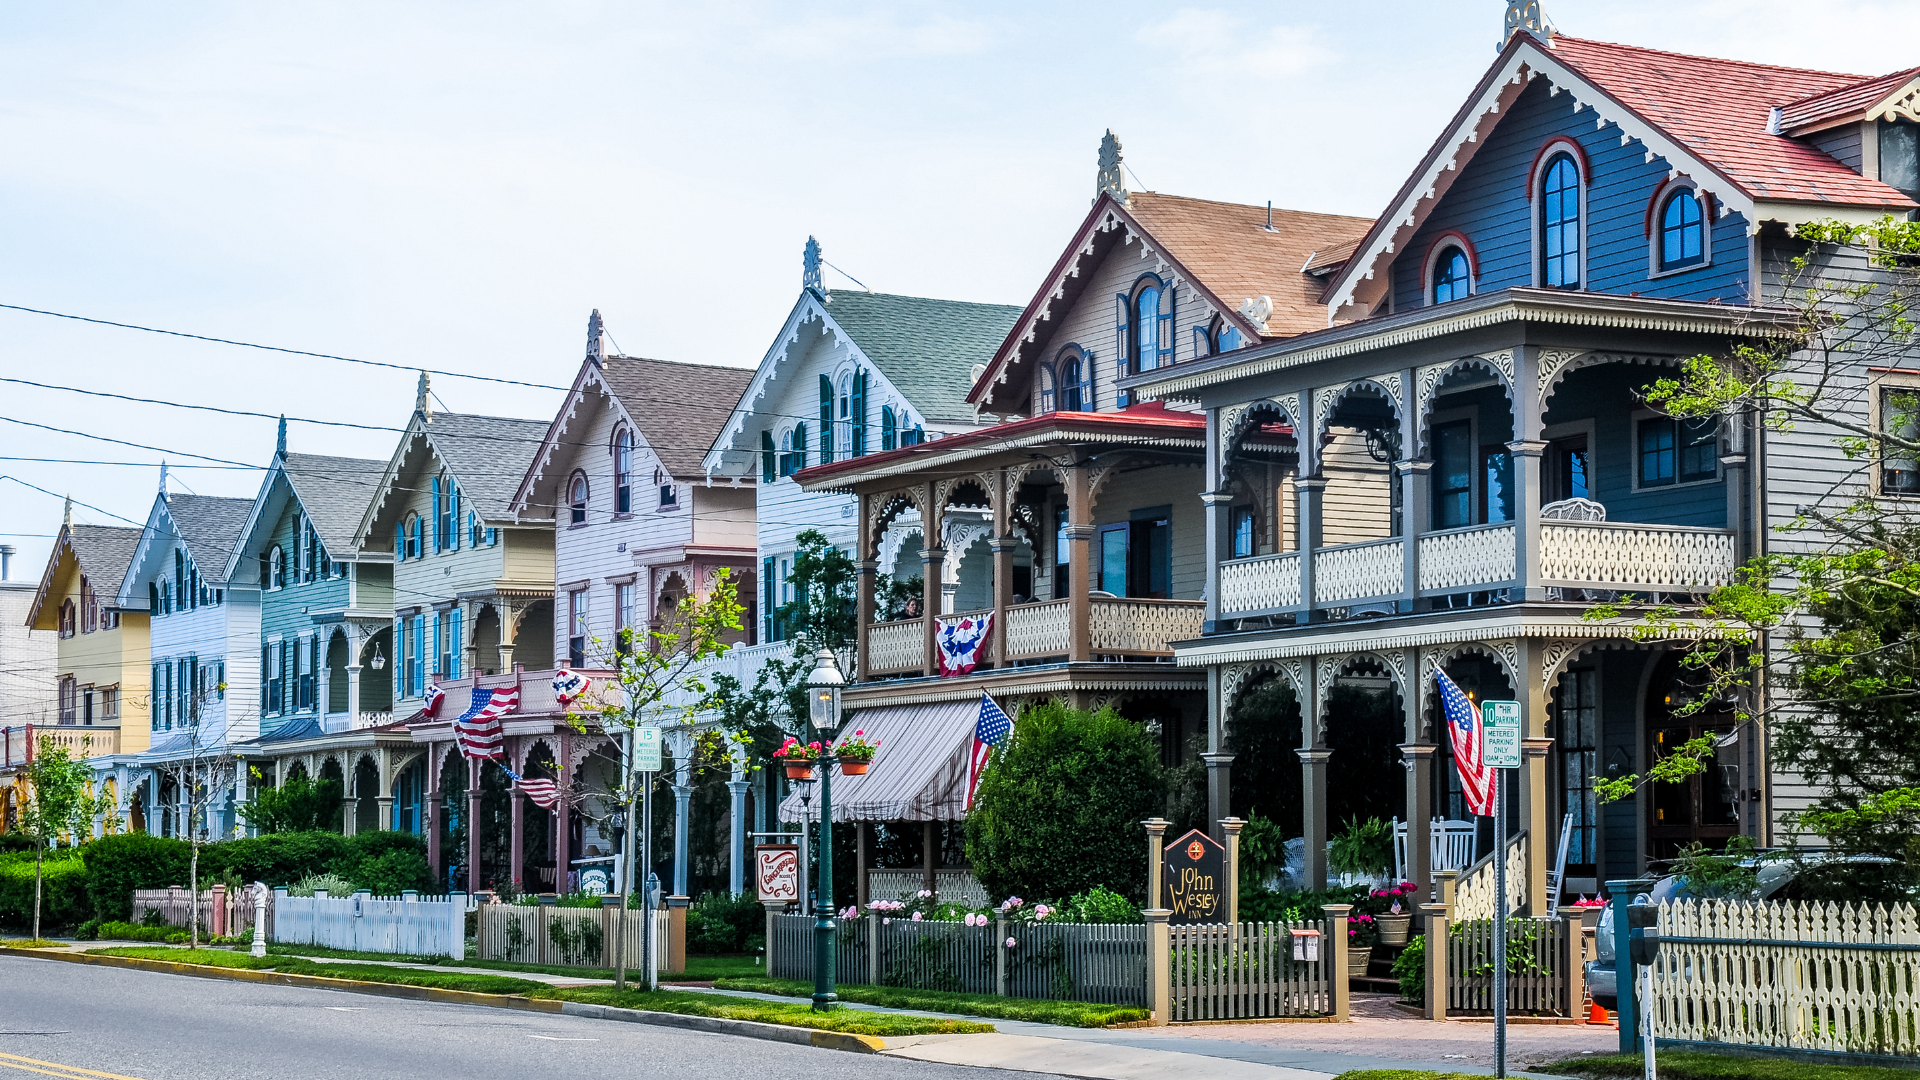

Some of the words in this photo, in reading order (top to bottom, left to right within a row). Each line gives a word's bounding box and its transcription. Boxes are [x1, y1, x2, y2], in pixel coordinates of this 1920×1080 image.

[1502, 705, 1511, 714] HR
[1485, 707, 1495, 723] 10
[1496, 716, 1518, 725] PARKING
[643, 730, 653, 740] 15
[1488, 730, 1514, 738] METERED
[1489, 738, 1513, 746] PARKING
[1494, 746, 1508, 754] ONLY
[1485, 754, 1499, 762] 10AM
[1504, 754, 1518, 762] 10PM
[1175, 867, 1214, 895] John
[1188, 910, 1202, 919] INN
